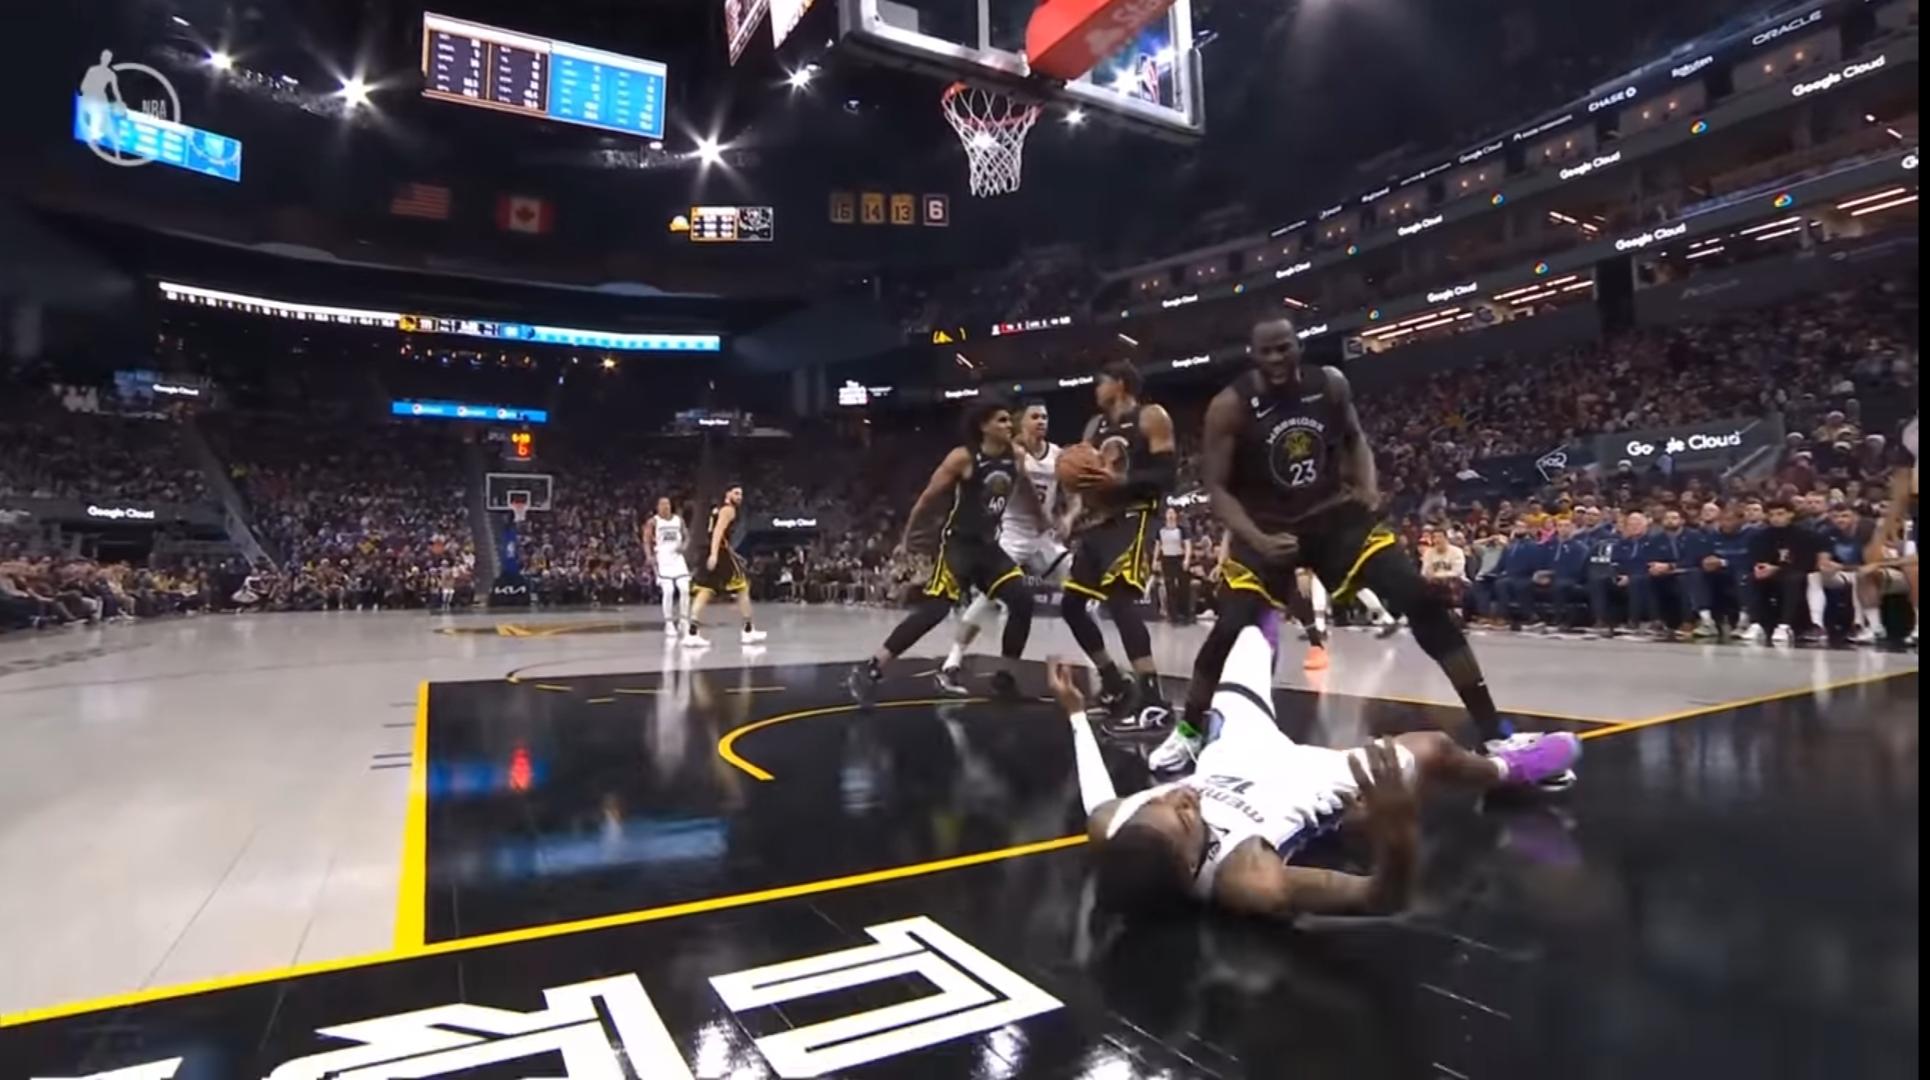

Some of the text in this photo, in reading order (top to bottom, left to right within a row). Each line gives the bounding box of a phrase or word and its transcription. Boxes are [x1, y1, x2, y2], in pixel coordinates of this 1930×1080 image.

[1752, 10, 1822, 45] ORACLE
[1792, 54, 1885, 97] Google Cloud
[1588, 91, 1625, 112] CHASE
[1559, 150, 1621, 180] Google Cloud
[894, 204, 912, 221] 13
[928, 200, 944, 220] 6
[1615, 221, 1687, 251] Google Cloud
[1426, 281, 1478, 303] Google Cloud
[1626, 430, 1741, 456] Gole Cloud
[1289, 458, 1318, 487] 23
[87, 504, 156, 520] Google Cloud
